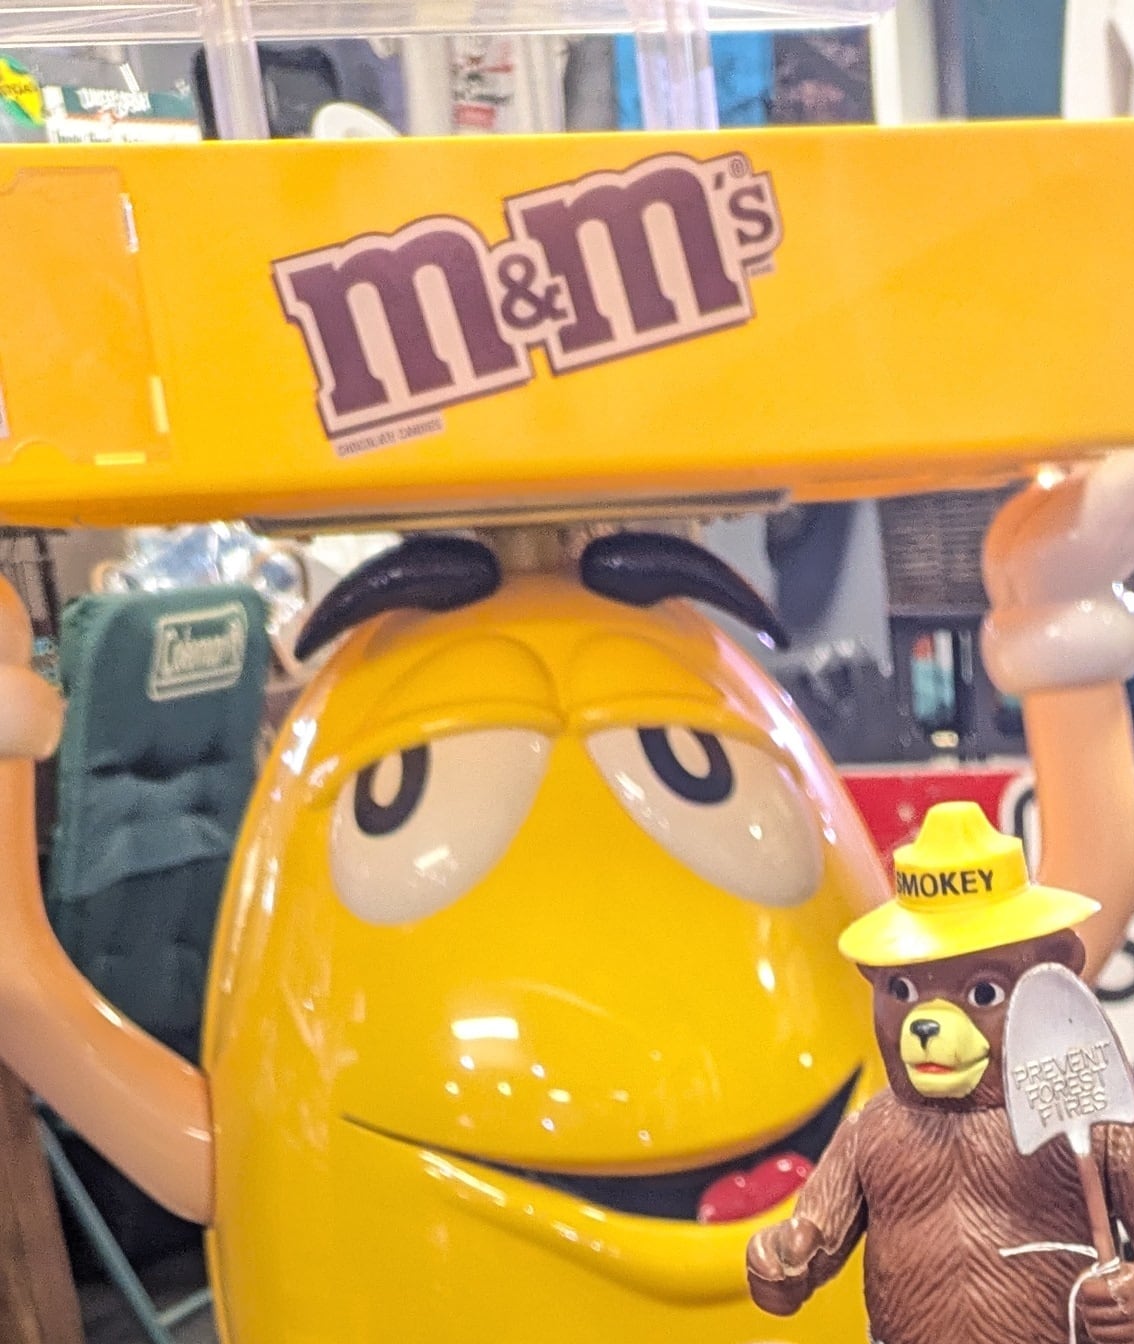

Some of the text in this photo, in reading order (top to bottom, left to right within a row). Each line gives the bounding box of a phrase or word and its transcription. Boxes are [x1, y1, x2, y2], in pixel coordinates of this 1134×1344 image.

[896, 868, 994, 898] SMOKEY
[1011, 1041, 1112, 1090] PREVENT
[1025, 1062, 1107, 1110] FOREST
[1038, 1086, 1108, 1128] FIRES
